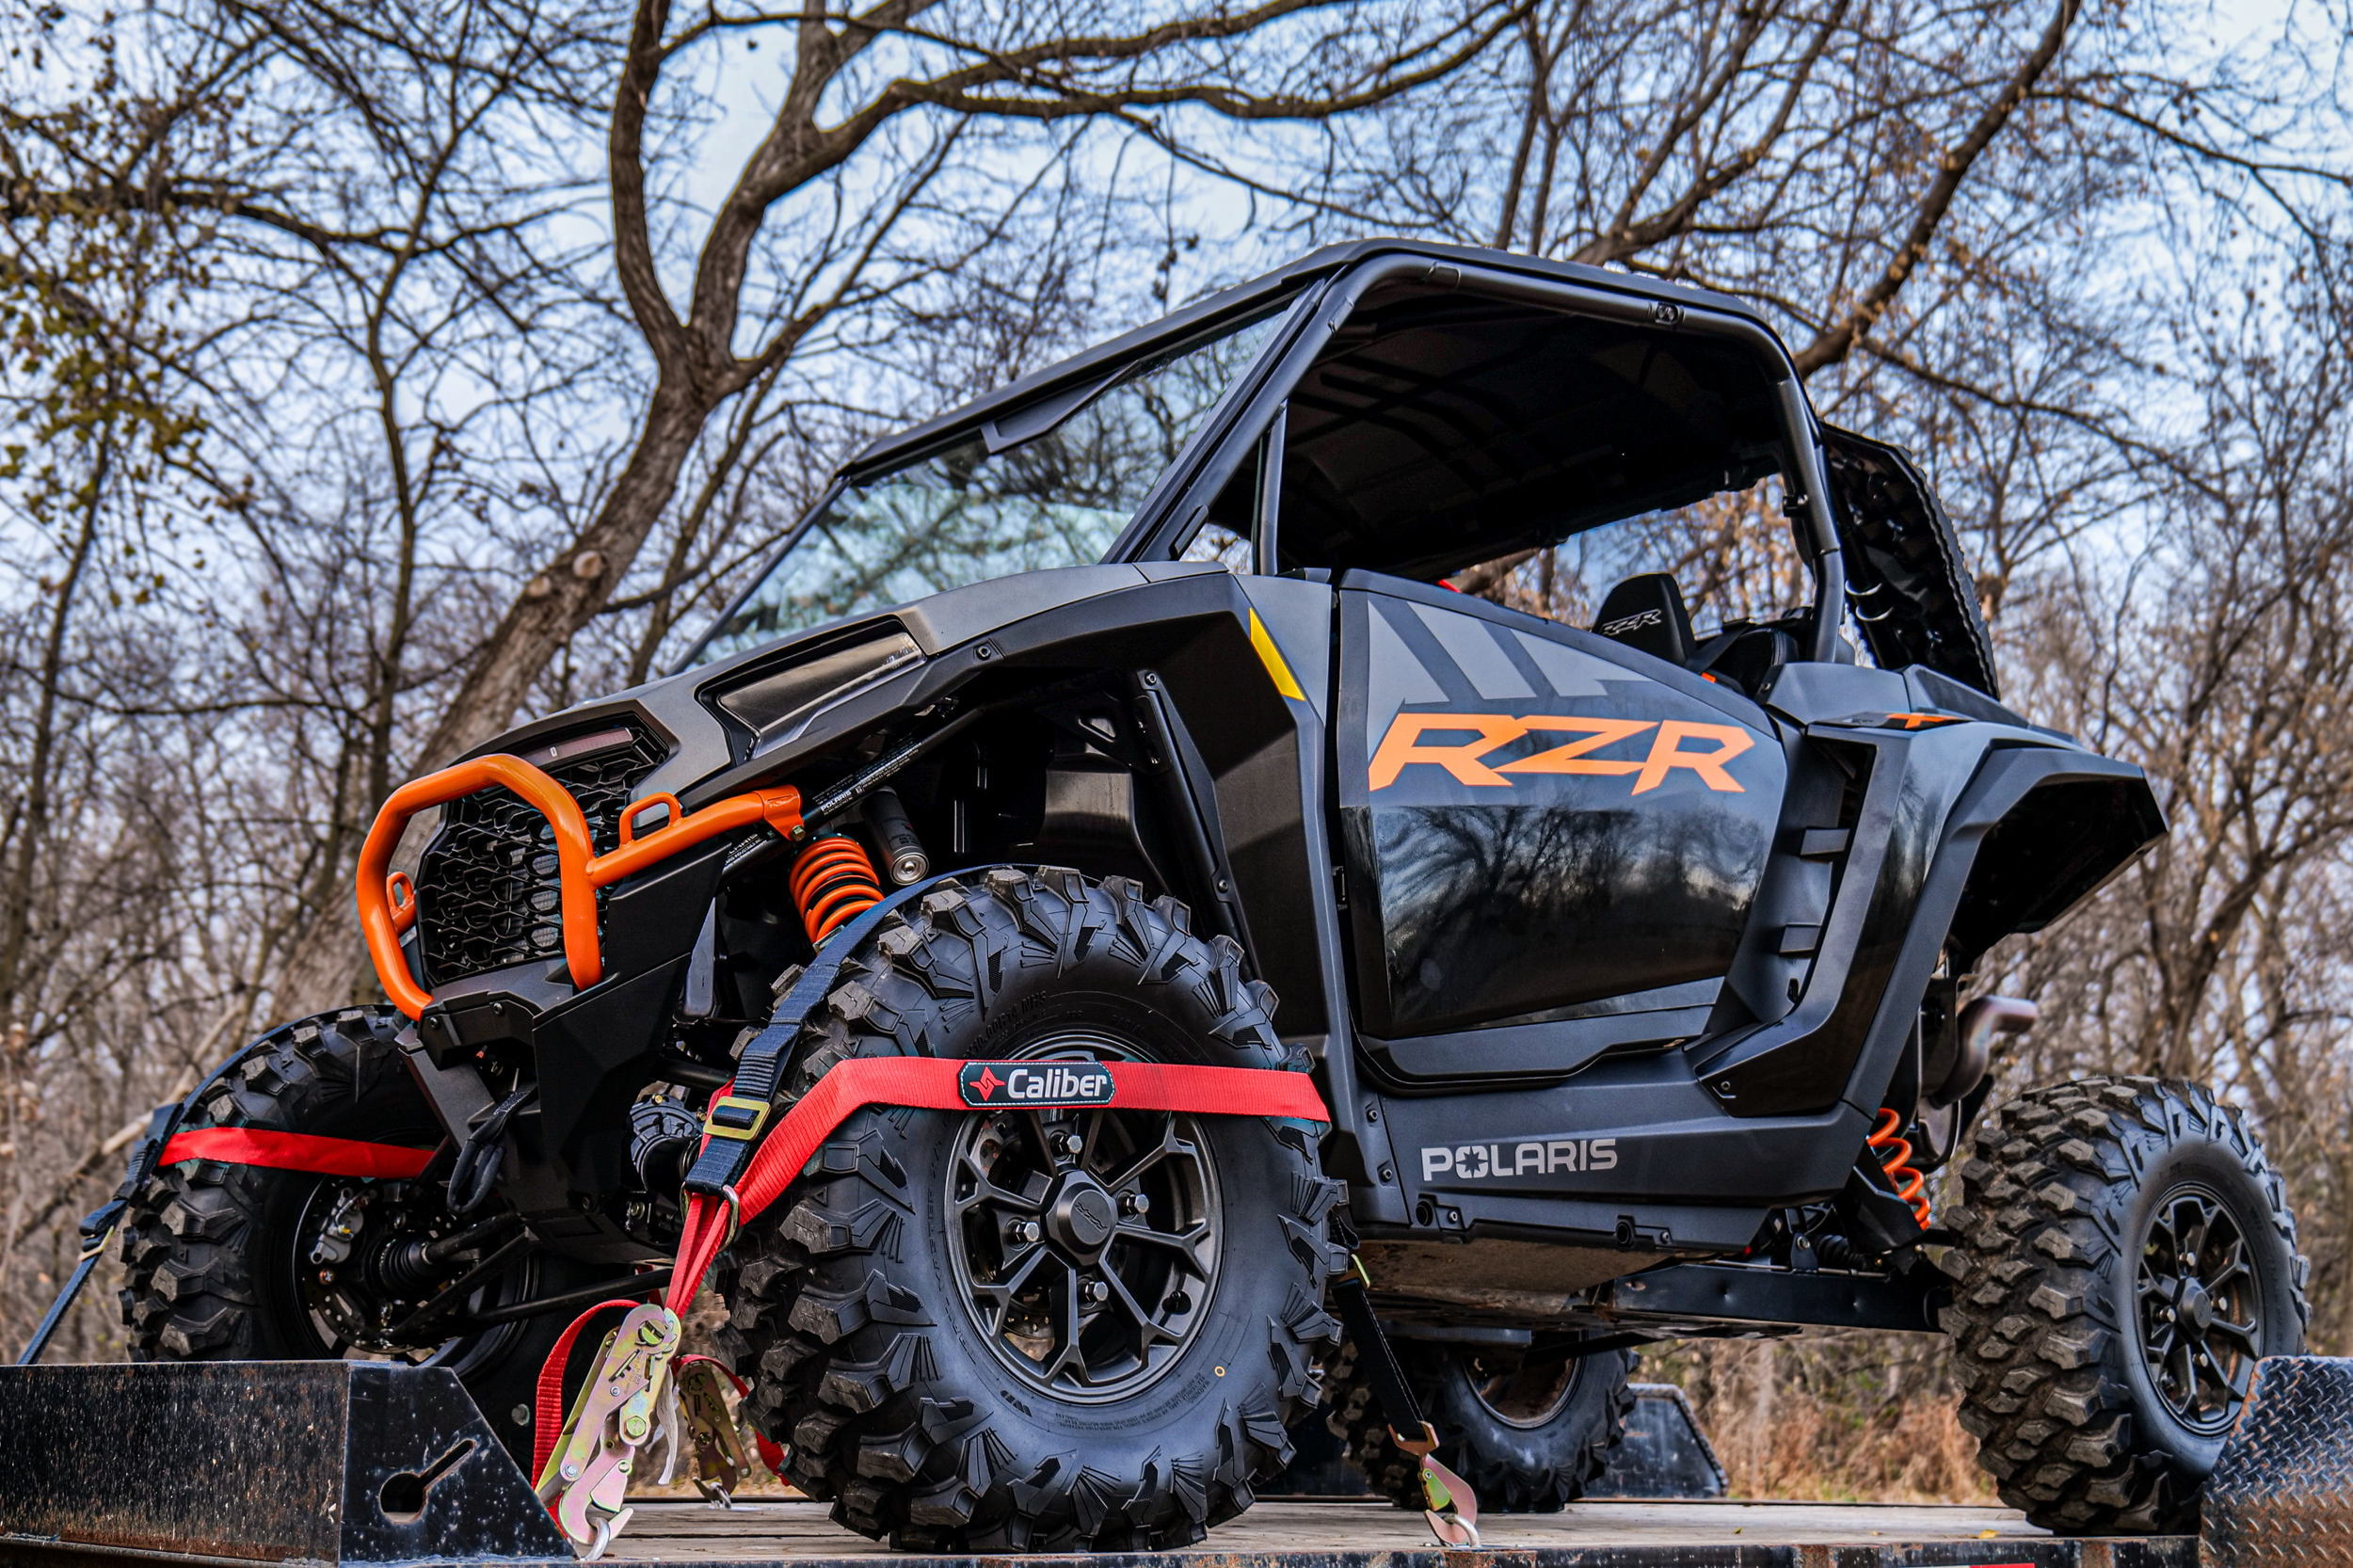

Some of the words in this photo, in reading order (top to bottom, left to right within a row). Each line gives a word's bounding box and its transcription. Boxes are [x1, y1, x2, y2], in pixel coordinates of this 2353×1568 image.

[1601, 608, 1661, 636] RZR
[1369, 712, 1755, 795] RZR
[821, 789, 852, 812] POLARIS
[1007, 1068, 1108, 1099] Caliber
[1420, 1138, 1618, 1182] POLARIS
